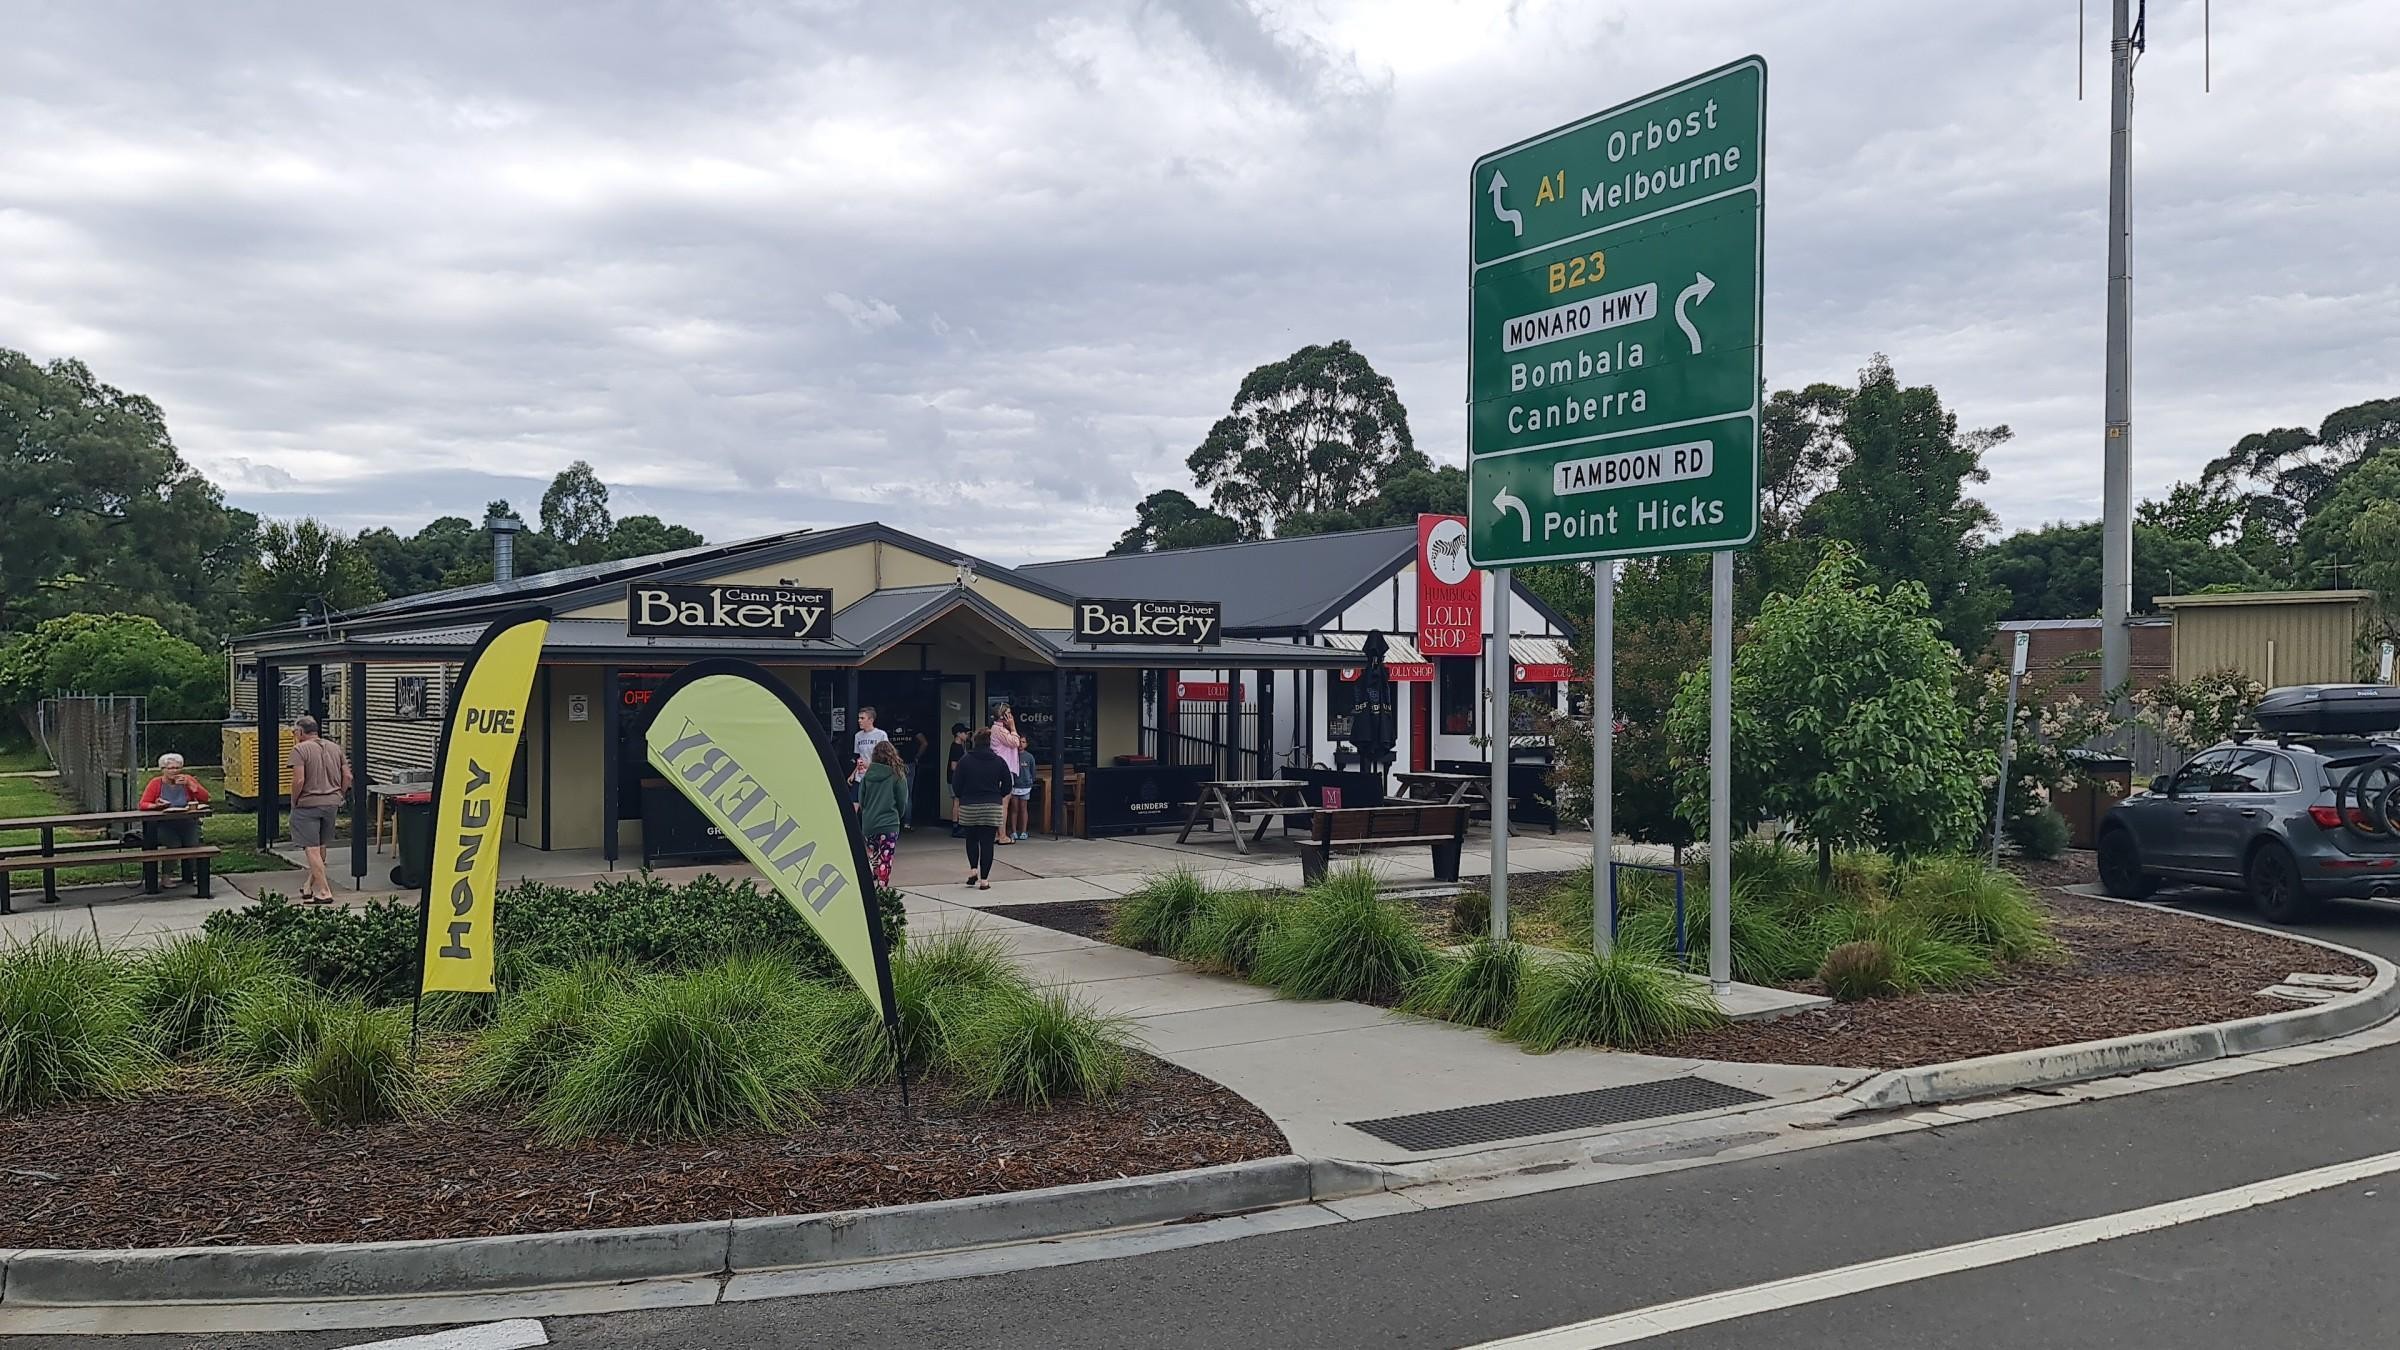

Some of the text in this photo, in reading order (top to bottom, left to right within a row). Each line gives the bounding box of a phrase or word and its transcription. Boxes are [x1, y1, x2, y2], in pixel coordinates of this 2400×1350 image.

[1606, 98, 1718, 163] Orbost
[1535, 170, 1565, 207] A1
[1580, 146, 1741, 217] Melbourne
[1548, 251, 1606, 294] B23
[1510, 290, 1648, 346] MONARO HWY
[1511, 341, 1643, 392] Bombala
[1508, 388, 1646, 434] Canberra
[1561, 447, 1704, 490] TAMBOON RD
[1544, 495, 1725, 541] Point Hicks
[637, 588, 825, 637] Bakery
[725, 589, 823, 603] Cann River
[1143, 603, 1215, 615] Cann River
[1426, 605, 1474, 626] LOLLY
[1081, 602, 1216, 644] Bakery
[1424, 628, 1466, 648] SHOP
[2017, 635, 2028, 646] 2P
[1390, 667, 1432, 677] OLLY SHOP
[465, 708, 516, 734] PURE
[1130, 801, 1169, 811] GRINDERS
[439, 758, 492, 960] HONEY
